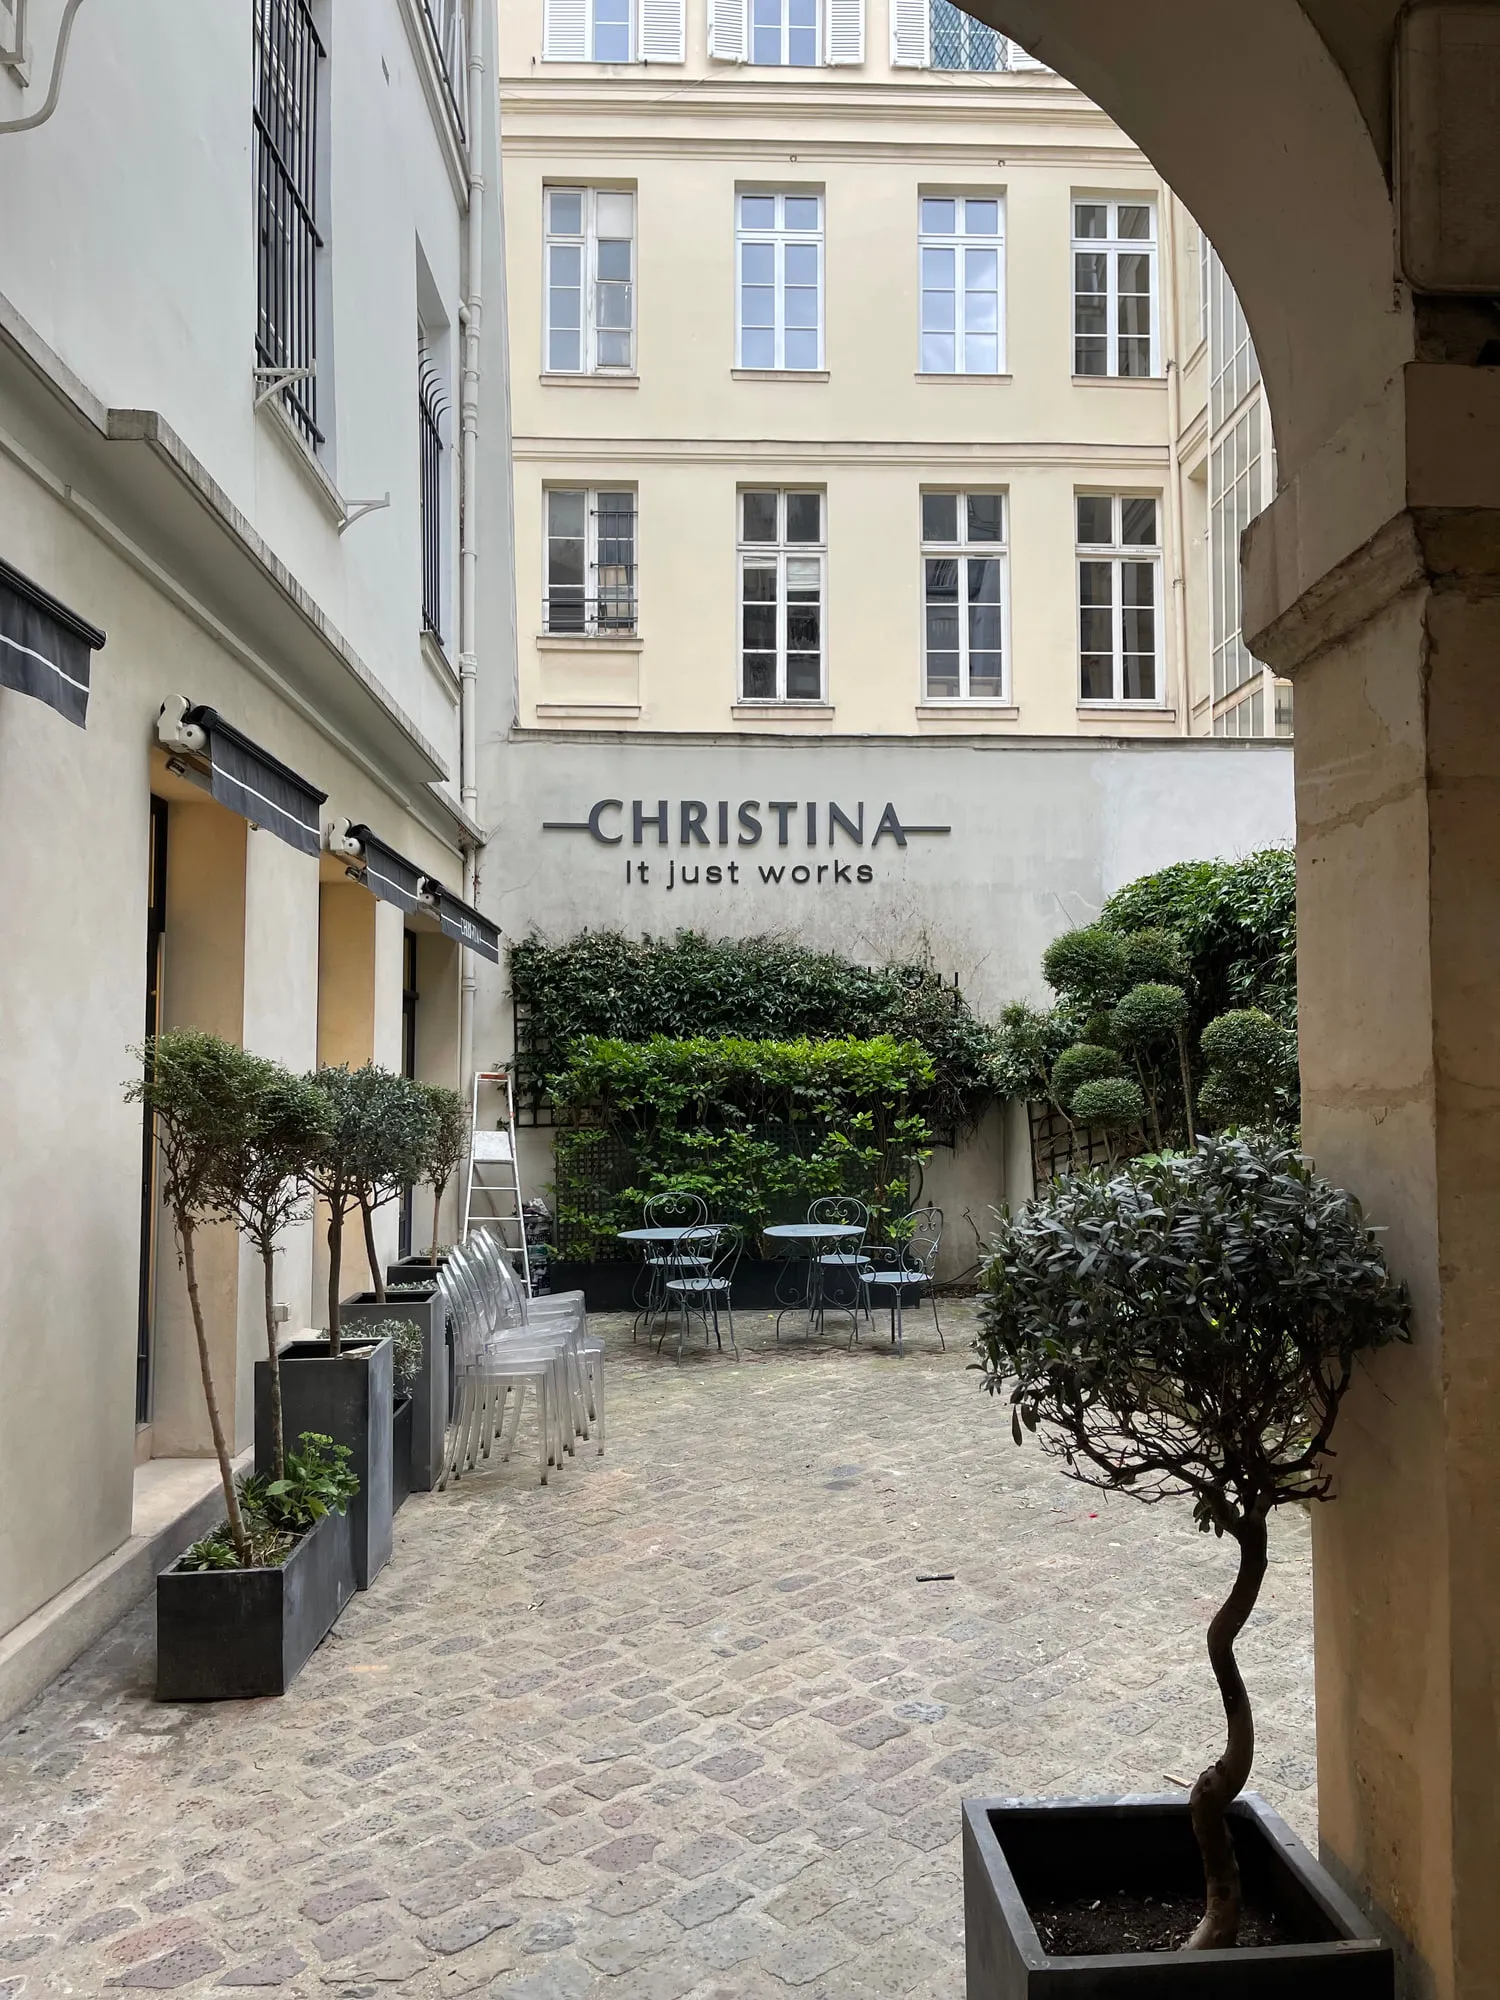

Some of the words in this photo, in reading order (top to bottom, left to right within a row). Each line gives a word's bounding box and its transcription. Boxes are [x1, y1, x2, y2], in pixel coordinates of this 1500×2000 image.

[588, 799, 908, 846] CHRISTINA
[626, 860, 650, 884] It
[666, 859, 740, 890] just
[757, 859, 874, 884] works
